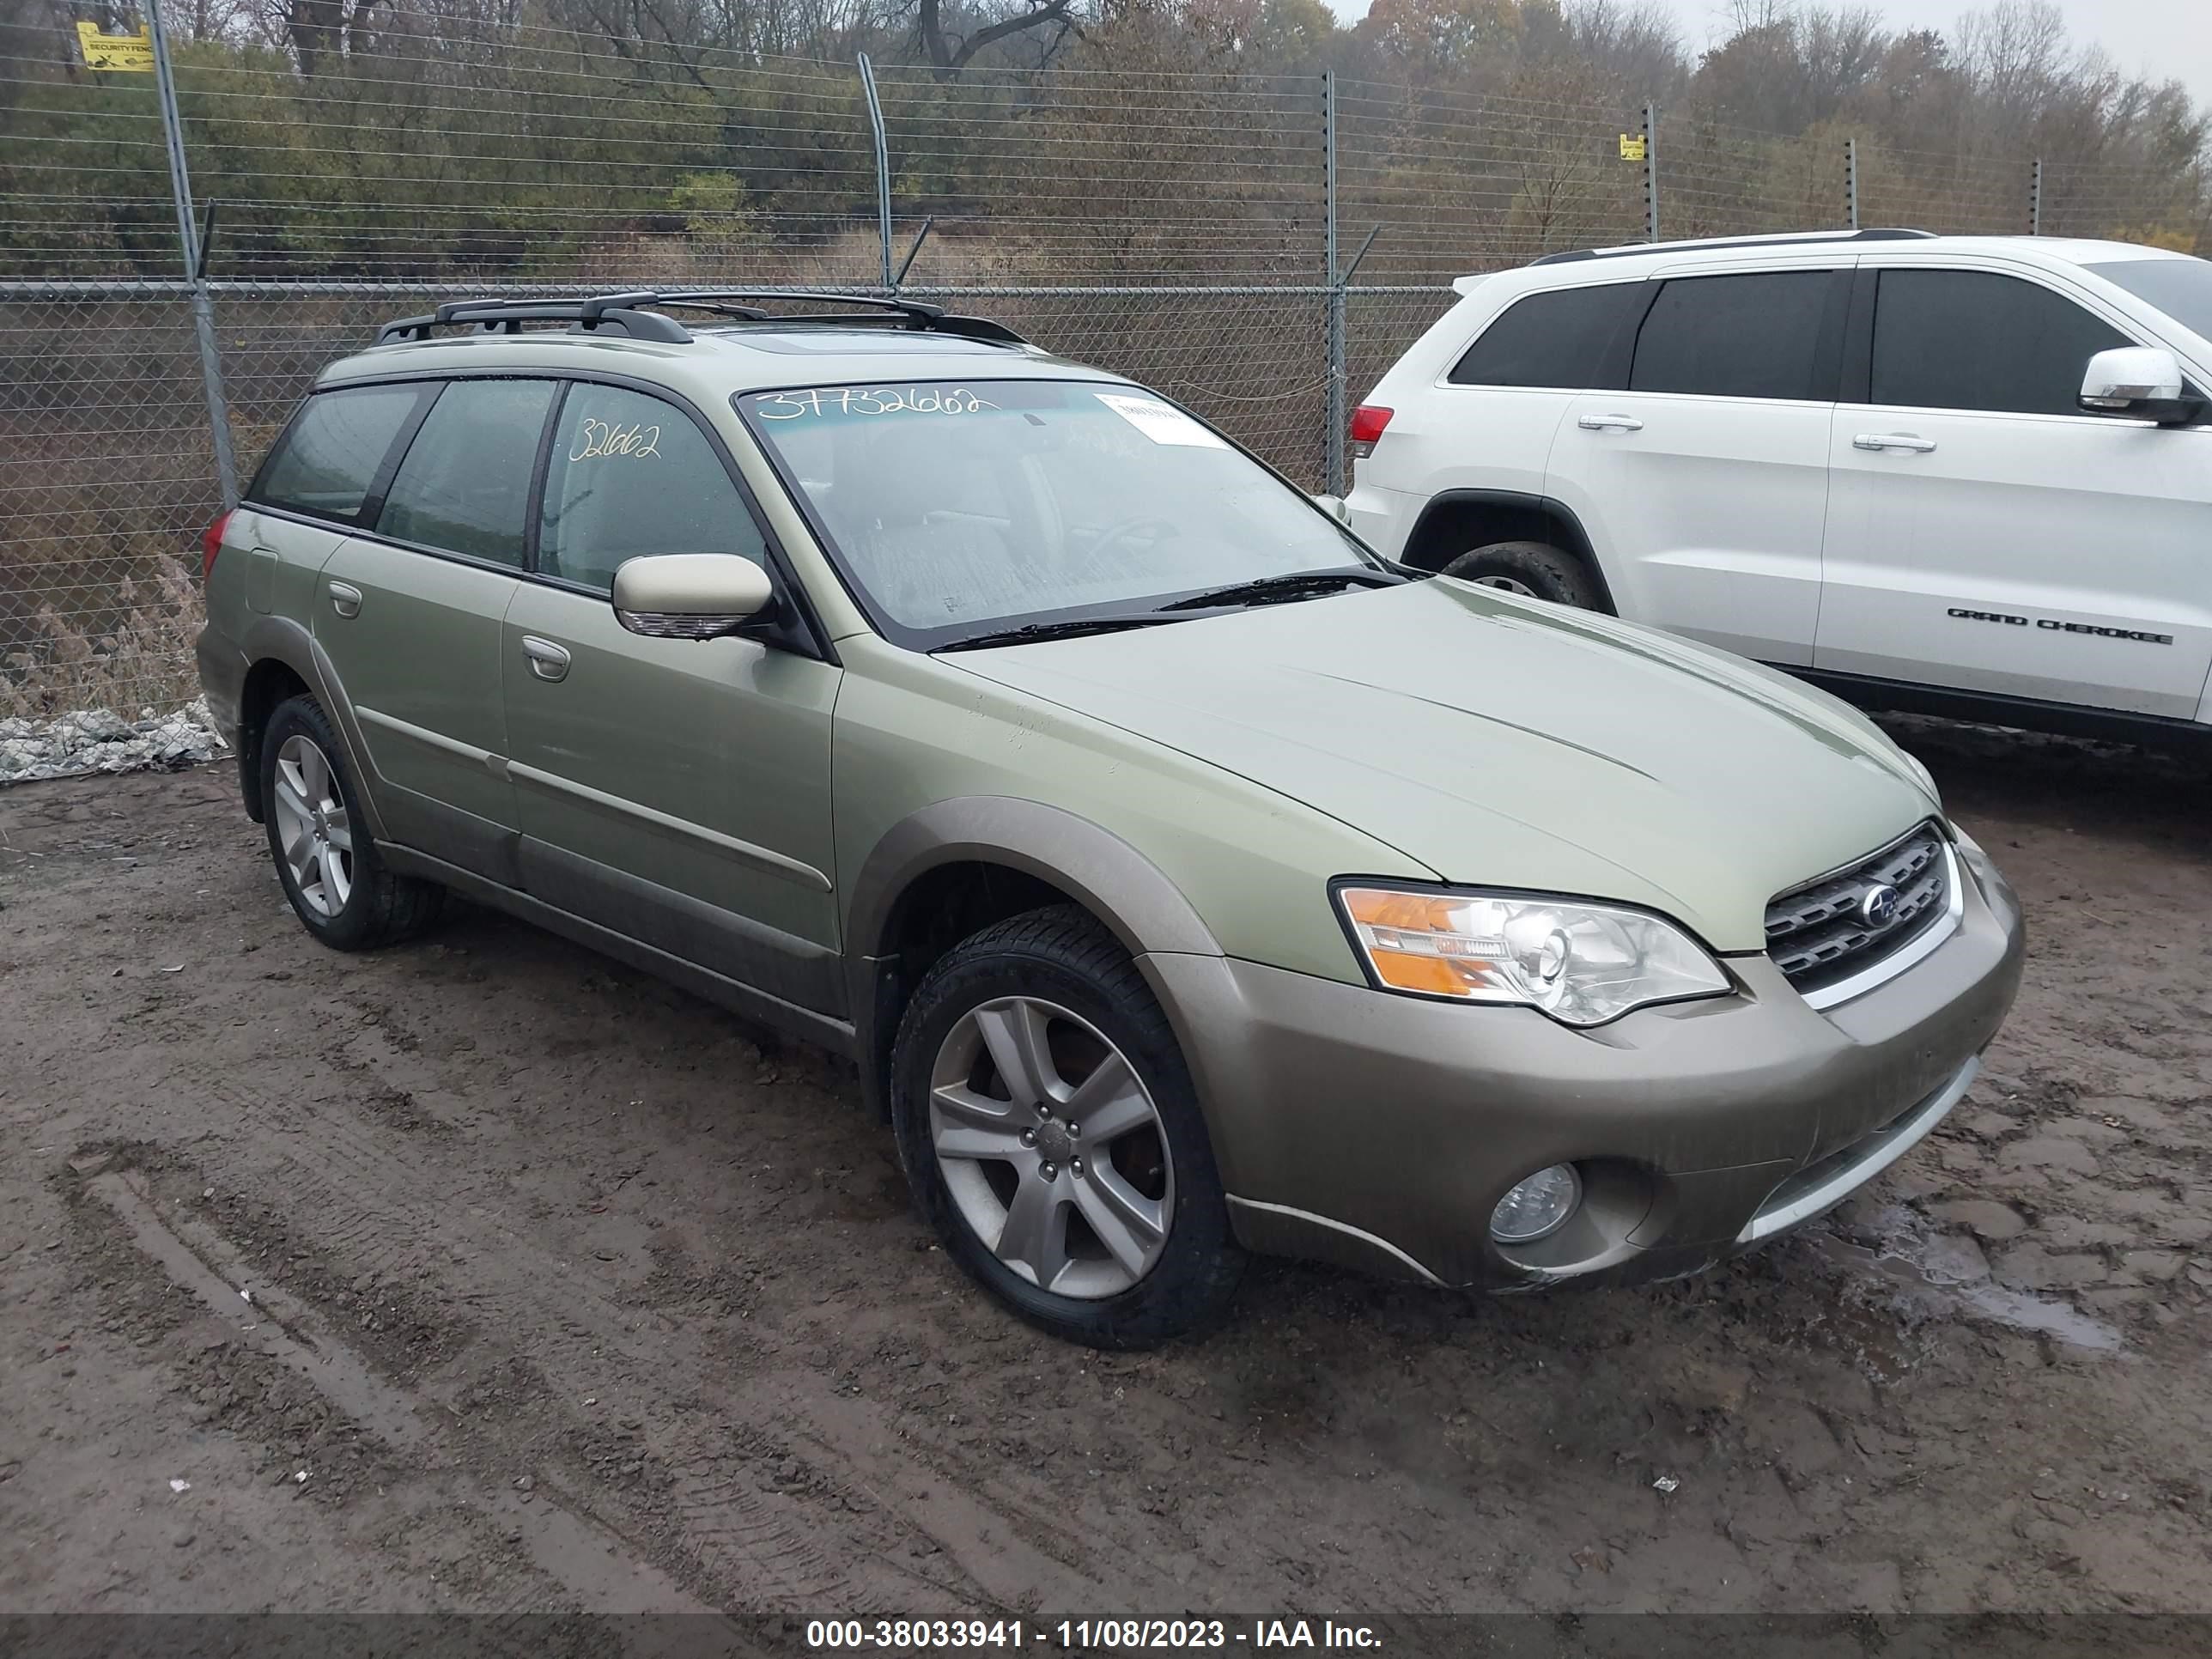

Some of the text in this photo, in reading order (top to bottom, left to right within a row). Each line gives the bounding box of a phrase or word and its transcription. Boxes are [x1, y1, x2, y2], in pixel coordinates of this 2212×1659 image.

[756, 389, 1002, 419] 37732662
[569, 418, 662, 461] 32662
[1948, 608, 2174, 645] GRAND CHEROKEE
